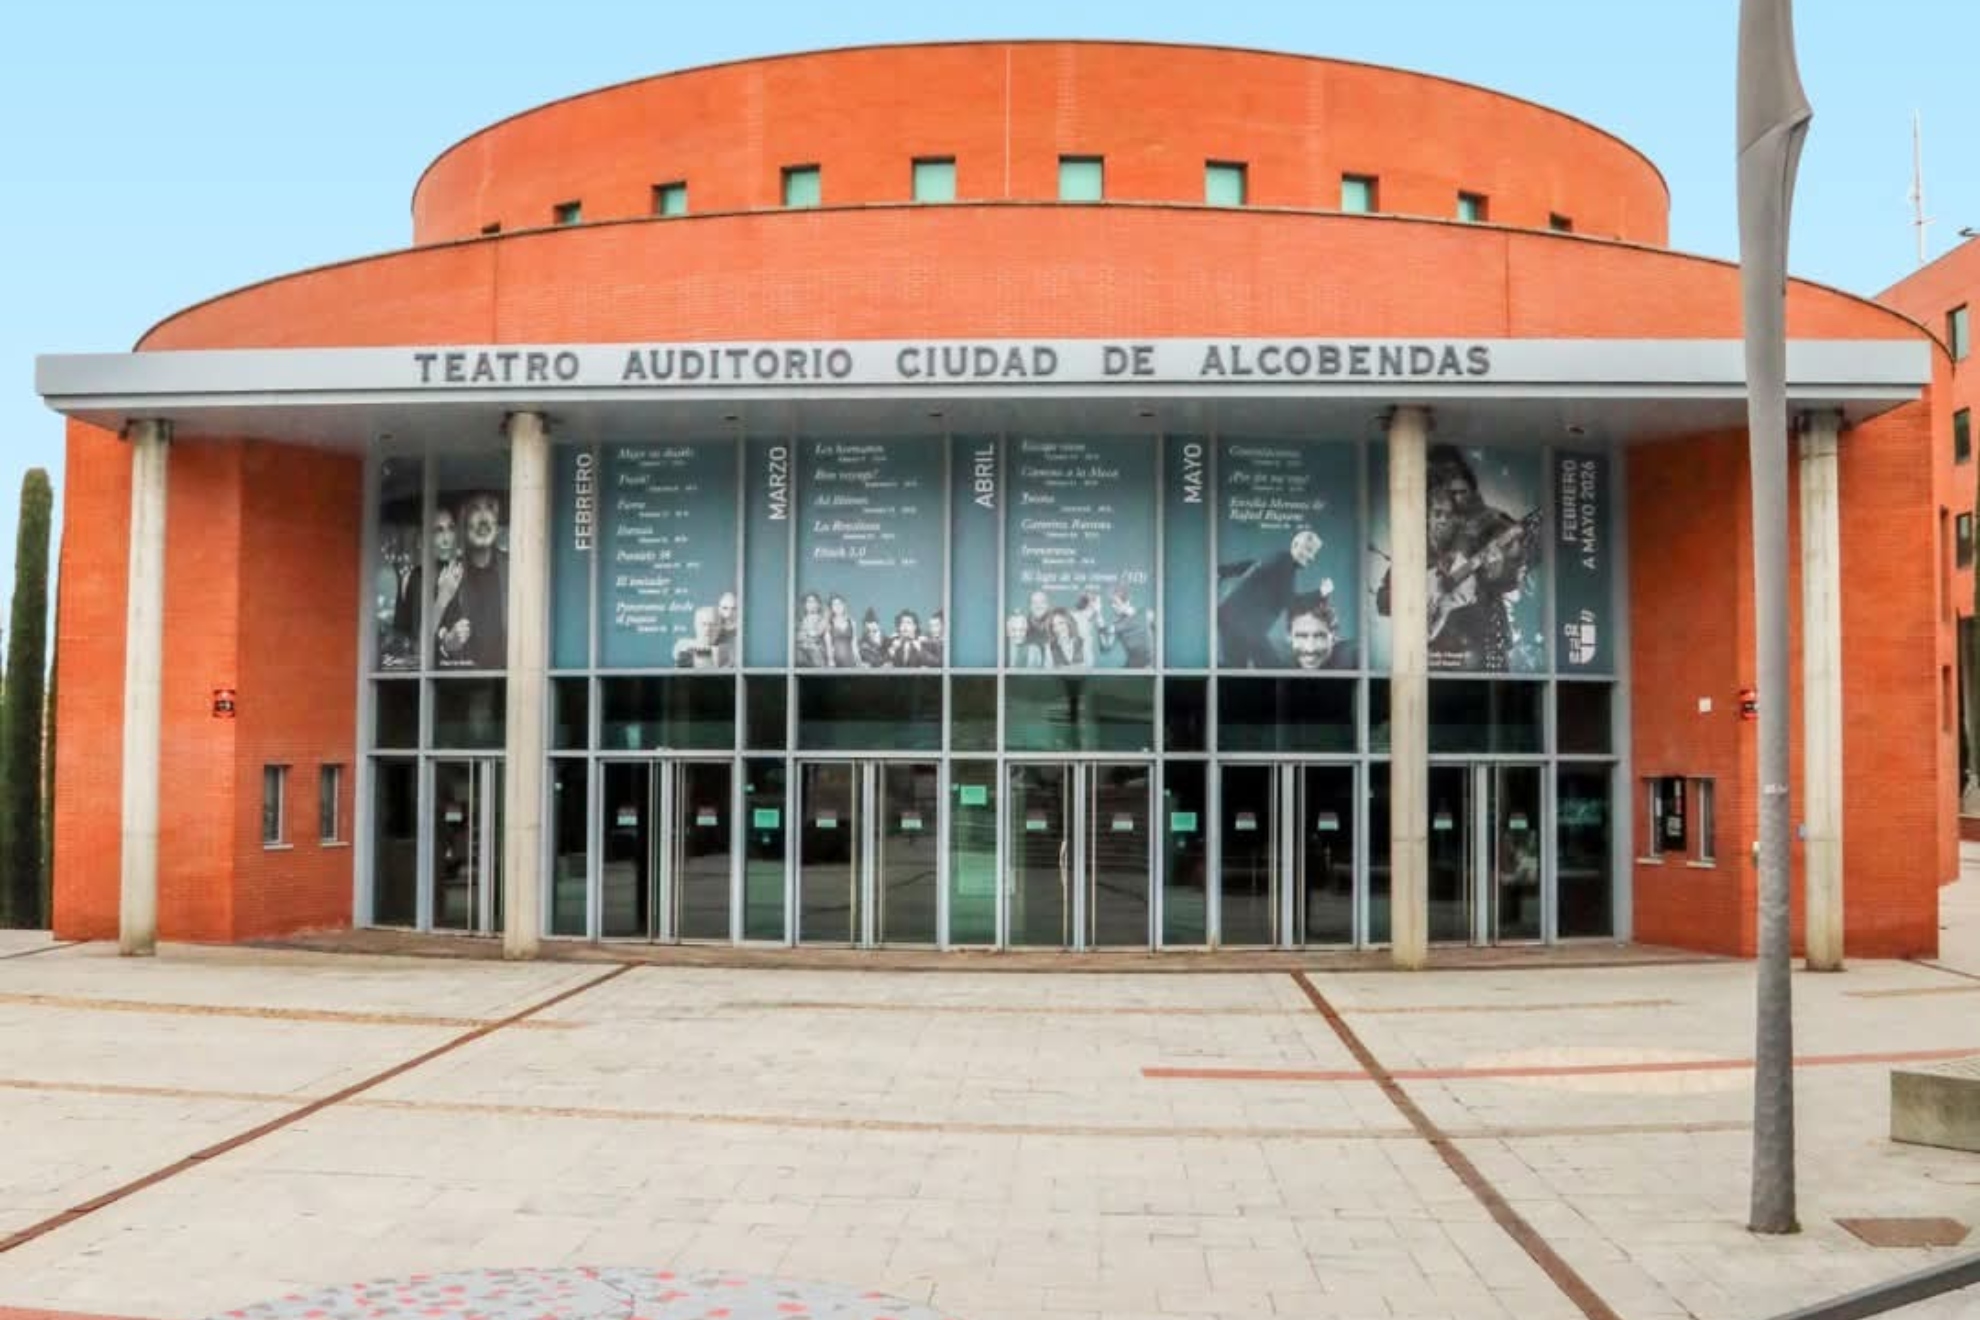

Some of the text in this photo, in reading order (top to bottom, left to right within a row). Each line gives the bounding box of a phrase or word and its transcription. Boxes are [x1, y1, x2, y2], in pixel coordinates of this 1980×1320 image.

[414, 345, 1491, 383] TEATRO AUDITORIO CIUDAD DE ALCOBENDAS
[575, 452, 594, 551] FEBRERO
[769, 446, 788, 521] MARZO
[974, 443, 995, 510] ABRIL
[1183, 443, 1203, 504] MAYO
[1562, 459, 1578, 542] FEBRERO
[1581, 460, 1597, 570] A MAYO 2026
